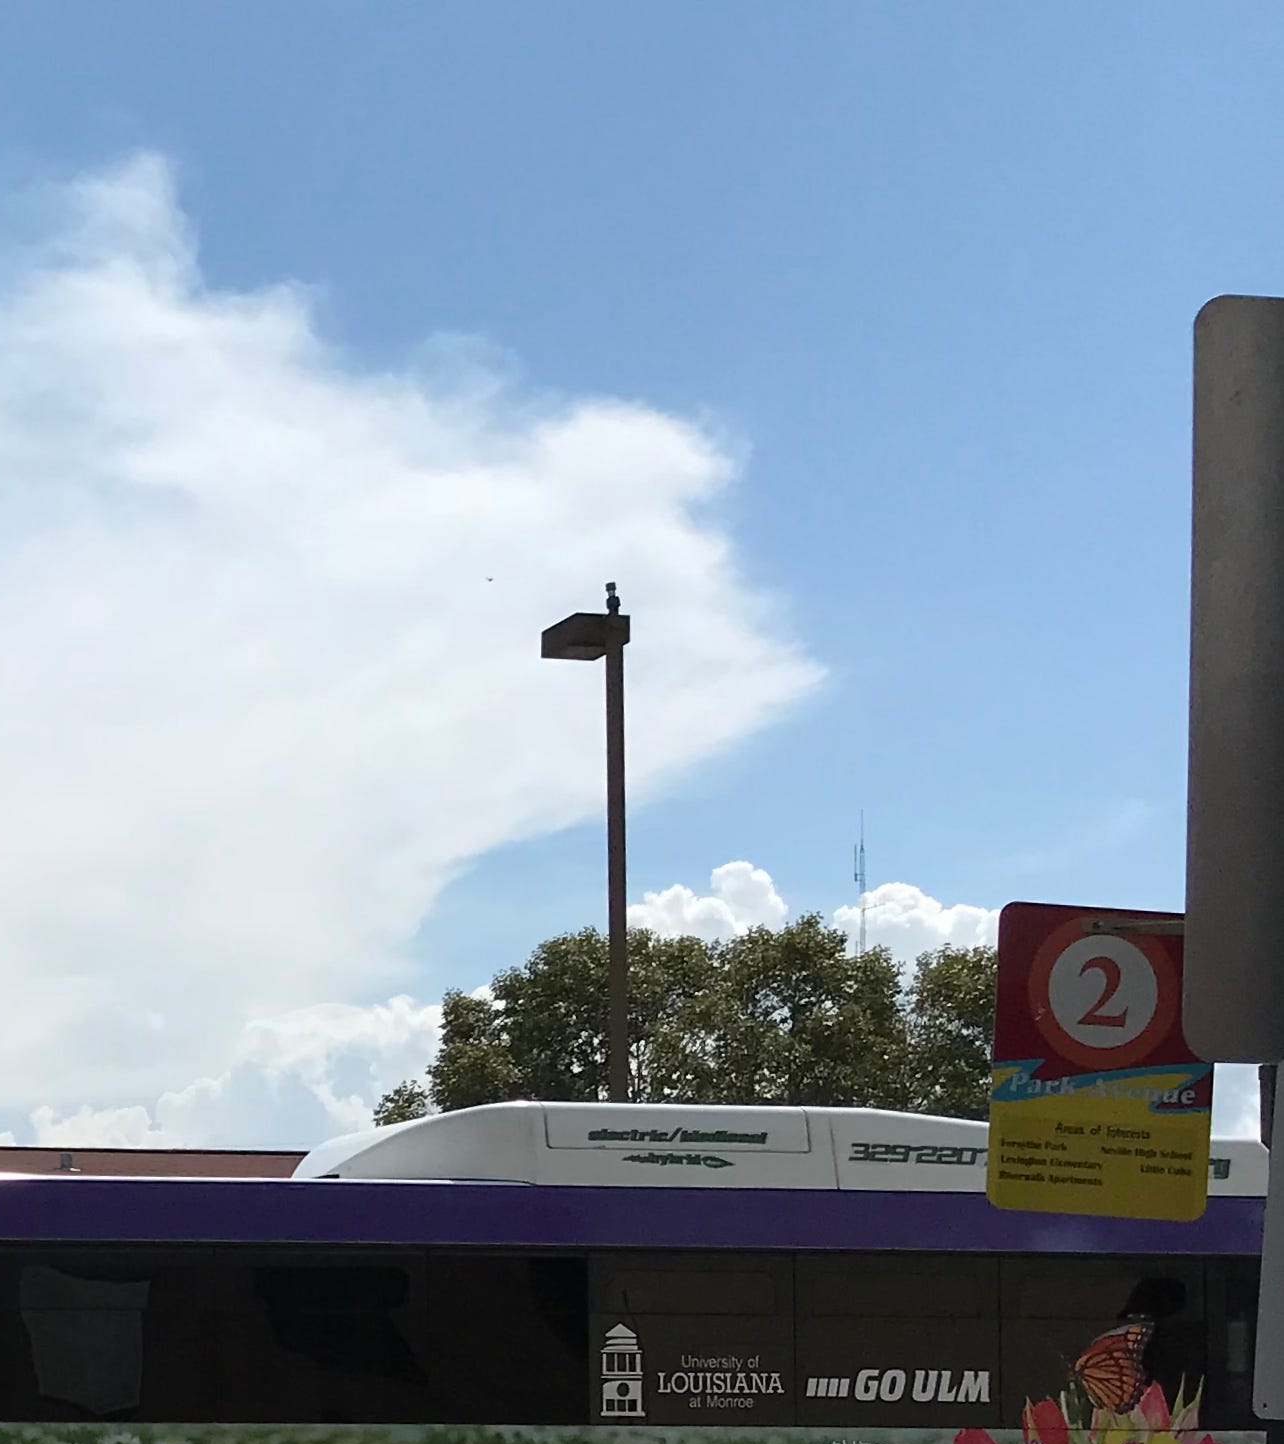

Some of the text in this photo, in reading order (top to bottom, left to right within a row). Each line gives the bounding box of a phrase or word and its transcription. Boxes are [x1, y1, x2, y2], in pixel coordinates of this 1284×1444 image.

[1076, 955, 1129, 1028] 2
[1009, 1072, 1196, 1105] Park Avenue
[1055, 1122, 1085, 1135] Areas
[1090, 1124, 1101, 1136] of
[1134, 1147, 1157, 1159] High
[681, 1354, 760, 1372] University of
[656, 1372, 785, 1394] LOUISIANA
[854, 1368, 991, 1403] GO ULM
[689, 1394, 754, 1409] at Monroe
